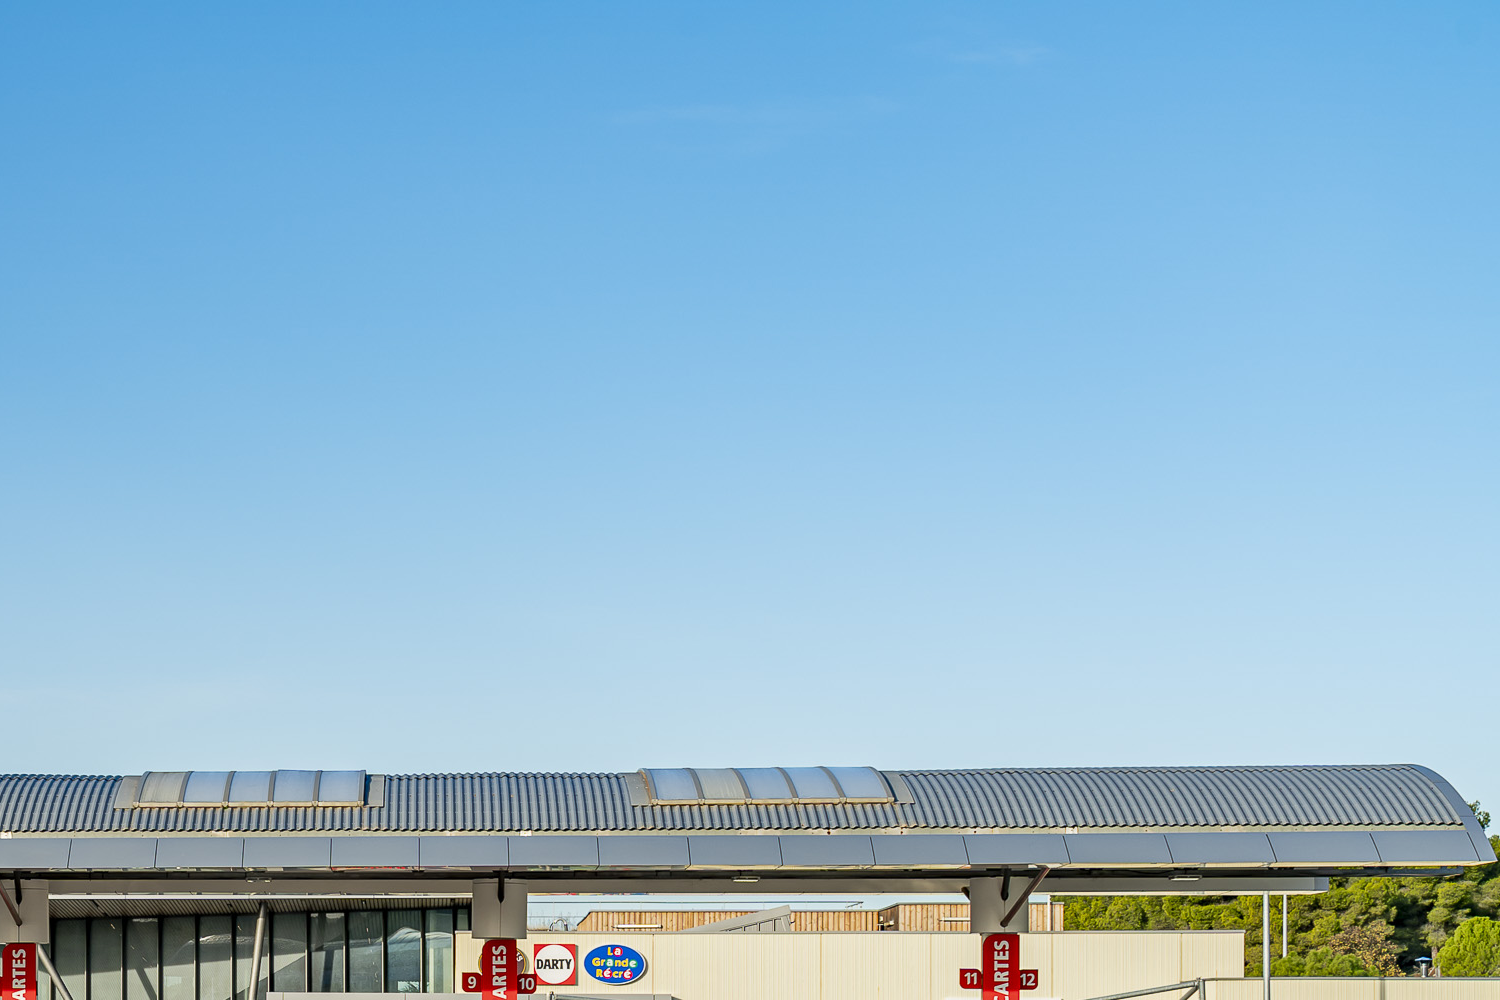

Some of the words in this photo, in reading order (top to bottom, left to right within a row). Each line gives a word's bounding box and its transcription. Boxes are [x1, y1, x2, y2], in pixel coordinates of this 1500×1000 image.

[607, 947, 622, 956] La
[536, 959, 572, 970] DARTY
[592, 957, 637, 967] Grande
[596, 968, 632, 979] Récré
[964, 972, 978, 985] 11
[1020, 973, 1036, 986] 12
[468, 976, 477, 989] 9
[519, 977, 535, 990] 10
